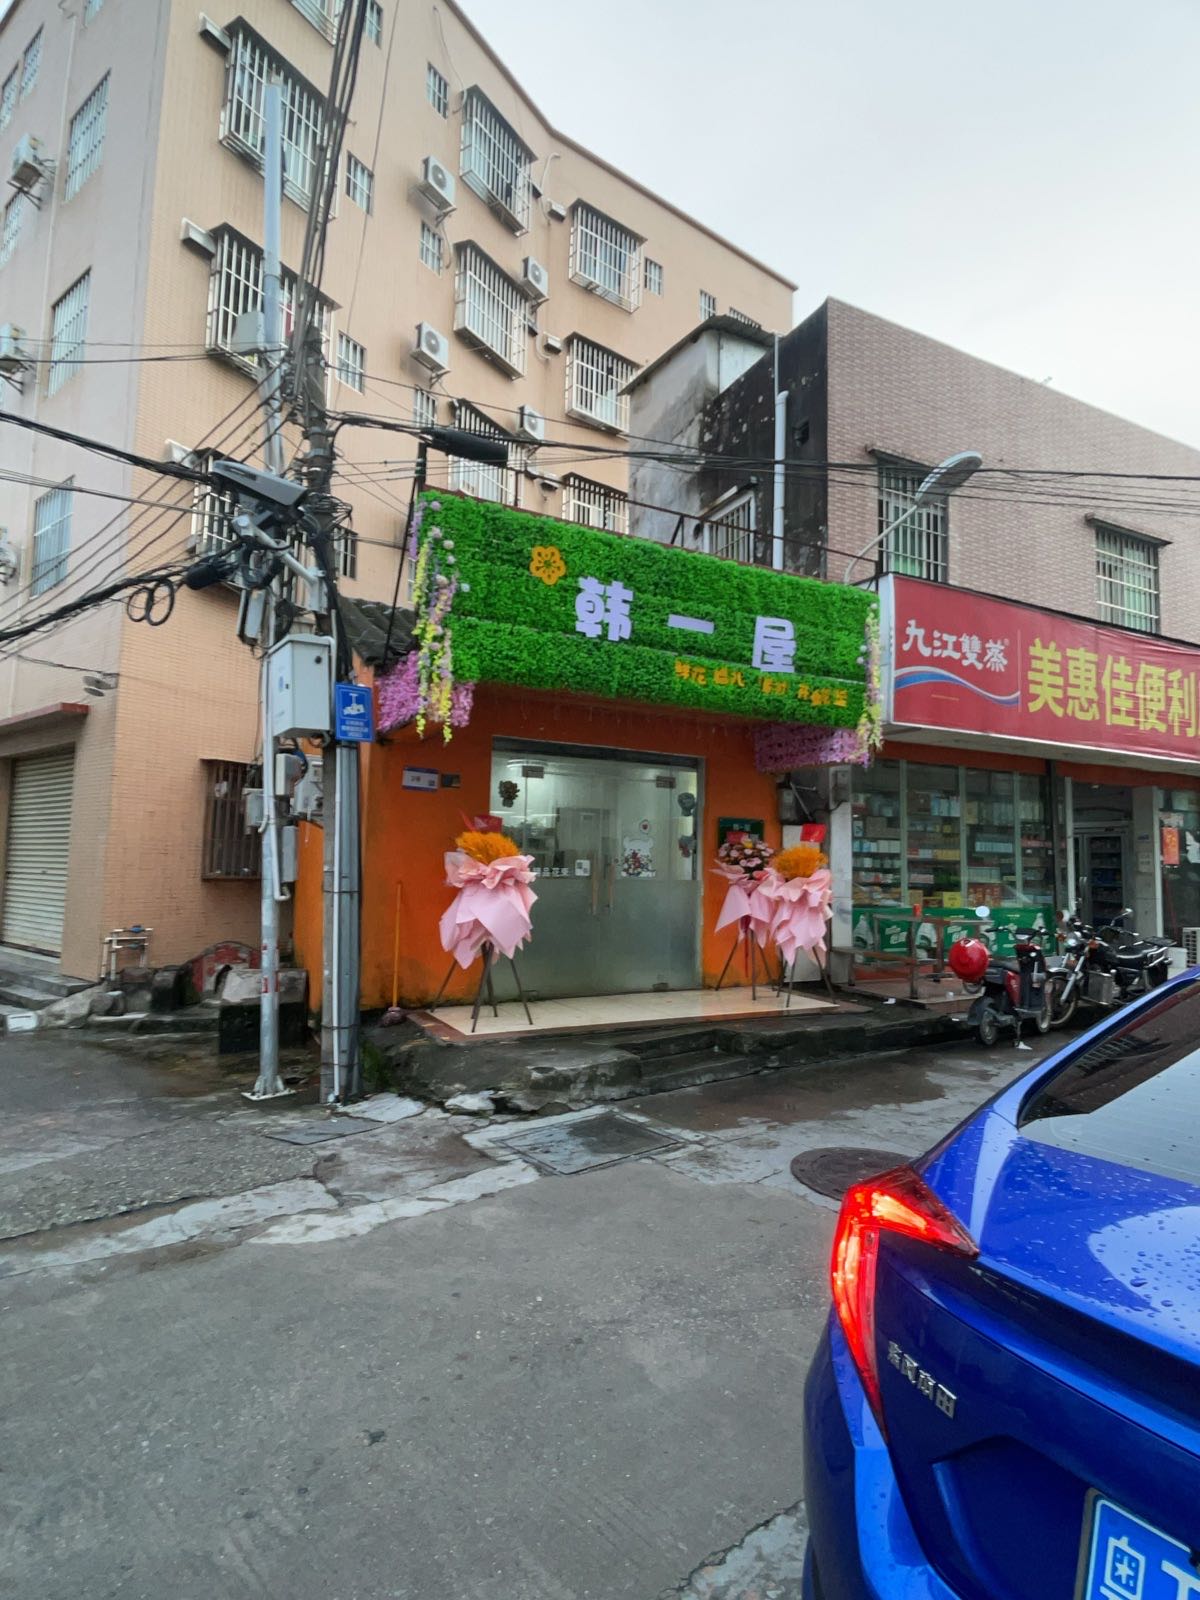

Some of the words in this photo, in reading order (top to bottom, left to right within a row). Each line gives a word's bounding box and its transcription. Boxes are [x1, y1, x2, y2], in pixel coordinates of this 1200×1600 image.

[575, 576, 796, 674] 韩一屋
[902, 619, 1008, 672] 九江雙蒸
[1027, 638, 1200, 738] 美惠佳便利
